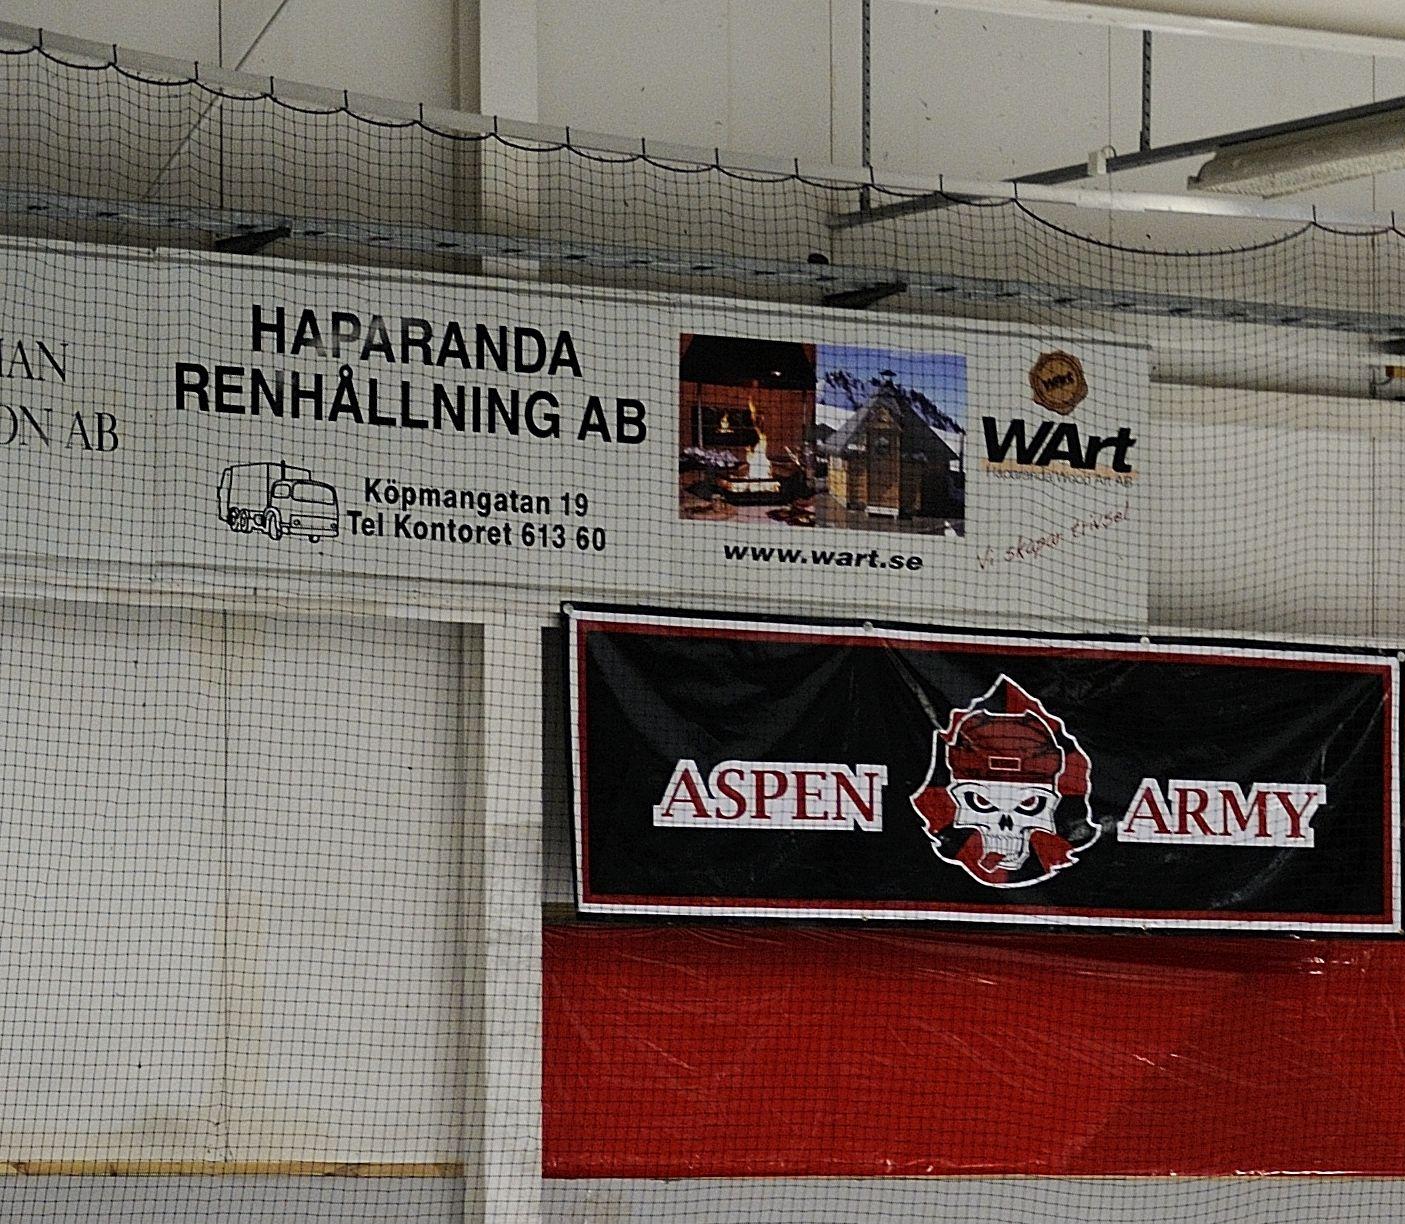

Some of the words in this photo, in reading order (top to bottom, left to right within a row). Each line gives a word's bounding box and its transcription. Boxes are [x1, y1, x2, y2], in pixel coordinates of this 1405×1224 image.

[0, 338, 68, 382] AN
[250, 304, 583, 378] HAPARANDA
[175, 362, 561, 439] RENHÅLLNING
[578, 397, 647, 445] AB
[65, 411, 119, 452] AB
[981, 416, 1137, 473] WArt
[364, 477, 550, 517] Köpmangatan
[561, 493, 589, 517] 19
[347, 510, 384, 537] Tel
[394, 513, 512, 546] Kontoret
[521, 522, 566, 549] 613
[576, 527, 606, 551] 60
[723, 543, 924, 572] www.wart.se
[656, 764, 884, 828] ASPEN
[1120, 783, 1323, 843] ARMY
